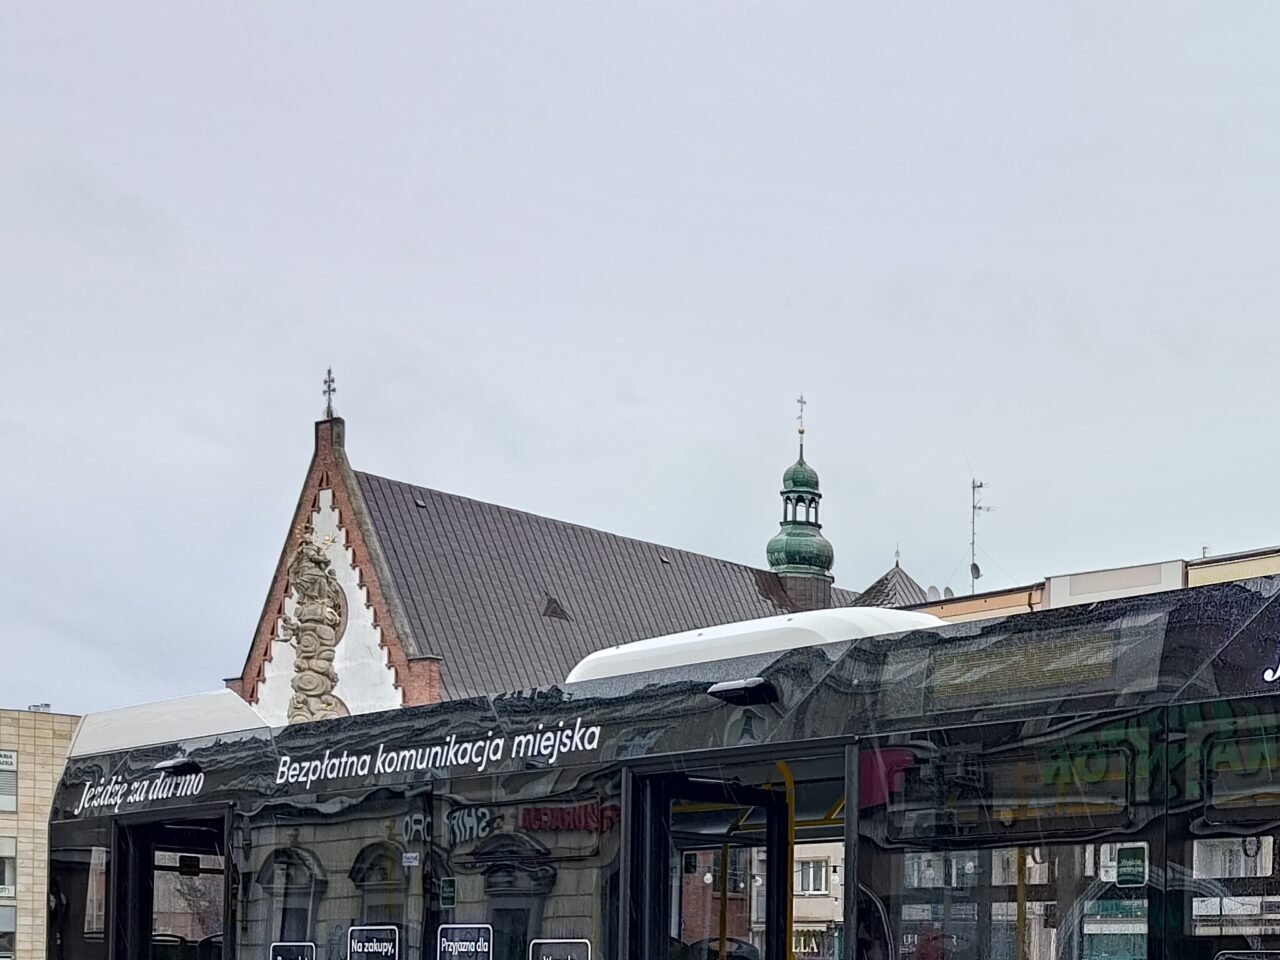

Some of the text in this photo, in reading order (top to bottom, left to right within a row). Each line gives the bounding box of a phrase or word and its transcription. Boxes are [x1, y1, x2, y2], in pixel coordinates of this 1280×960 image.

[276, 717, 601, 790] Bezpłatna komunikacja miejska
[74, 771, 204, 815] Jeżdżę za darmo
[351, 938, 395, 956] Na zakupy,
[441, 937, 489, 955] Przyjazna dla
